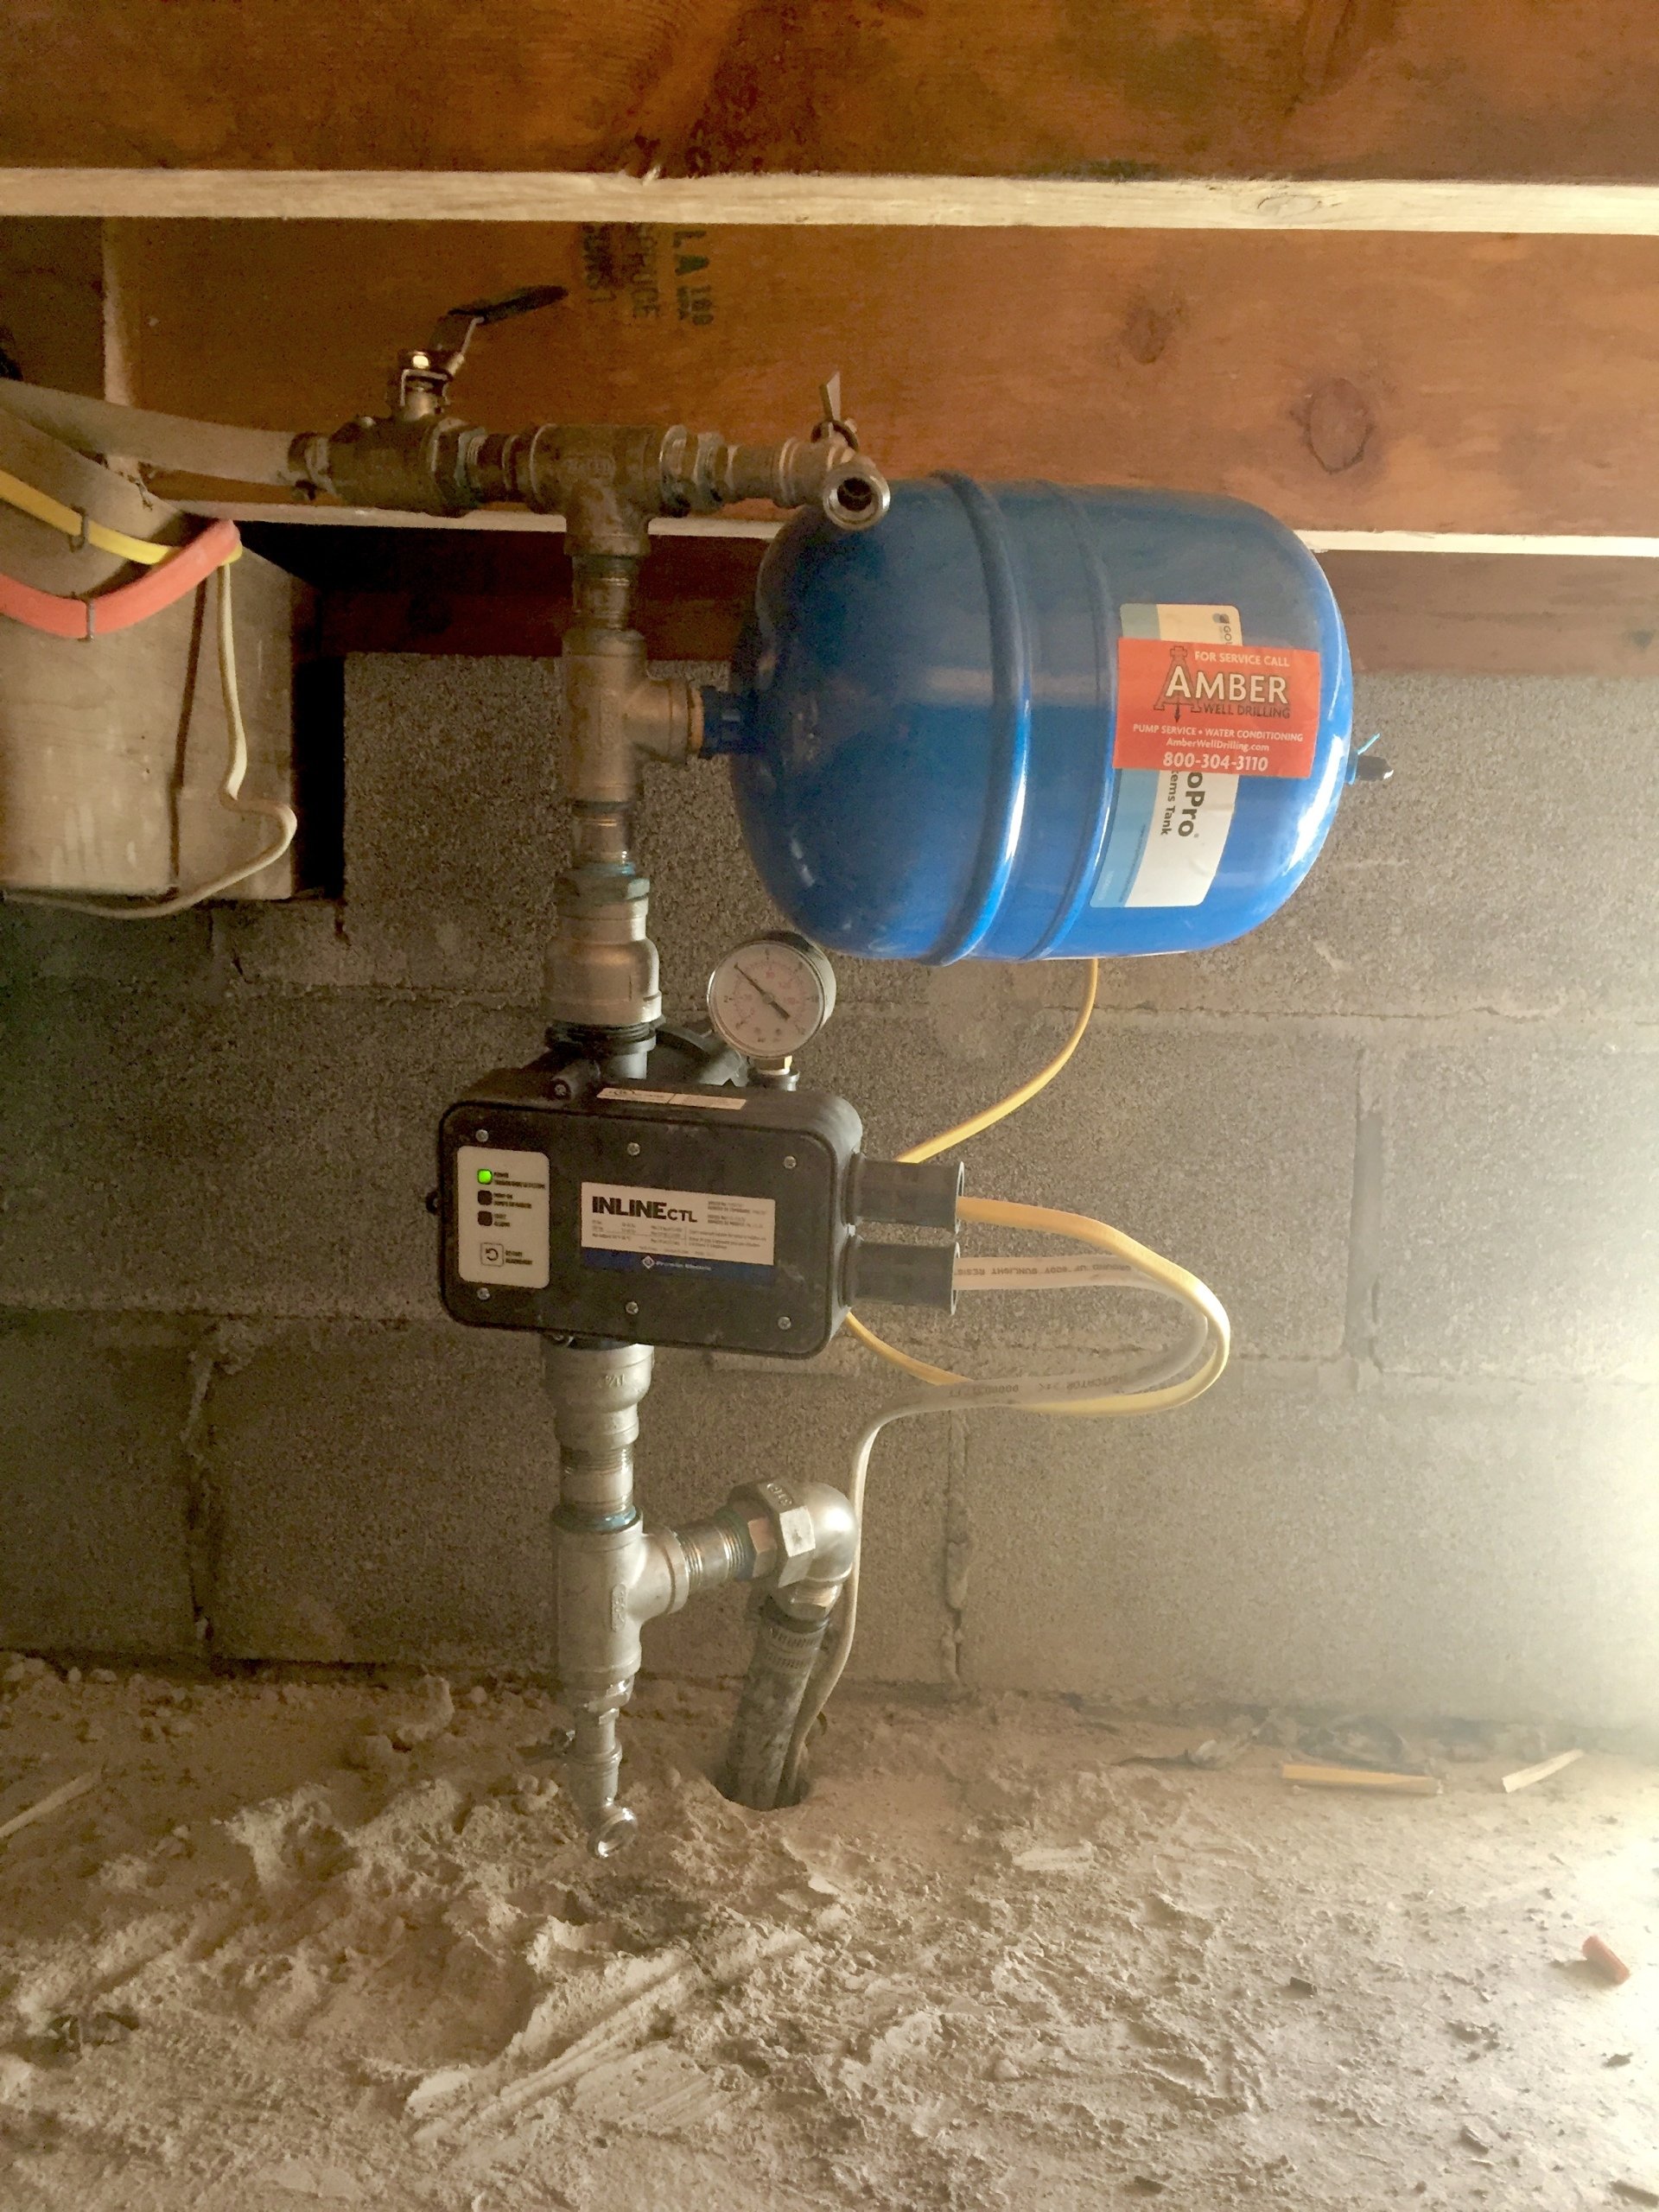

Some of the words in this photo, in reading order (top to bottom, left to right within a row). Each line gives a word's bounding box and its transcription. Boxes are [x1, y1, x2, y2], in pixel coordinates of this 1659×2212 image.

[1194, 651, 1217, 662] FOR
[1219, 652, 1262, 665] SERVICE
[1263, 655, 1290, 667] CALL
[1165, 665, 1288, 704] AMBER
[1203, 702, 1234, 715] WELL
[1236, 704, 1291, 719] DRILLING
[1133, 723, 1159, 734] PUMP
[1161, 725, 1197, 735] SERVICE
[1205, 728, 1235, 738] WATER
[1236, 730, 1303, 742] CONDITIONING
[1166, 737, 1270, 753] AmberWellDrilling.com
[1162, 751, 1268, 772] 800-304-3110
[1160, 806, 1176, 836] Tank
